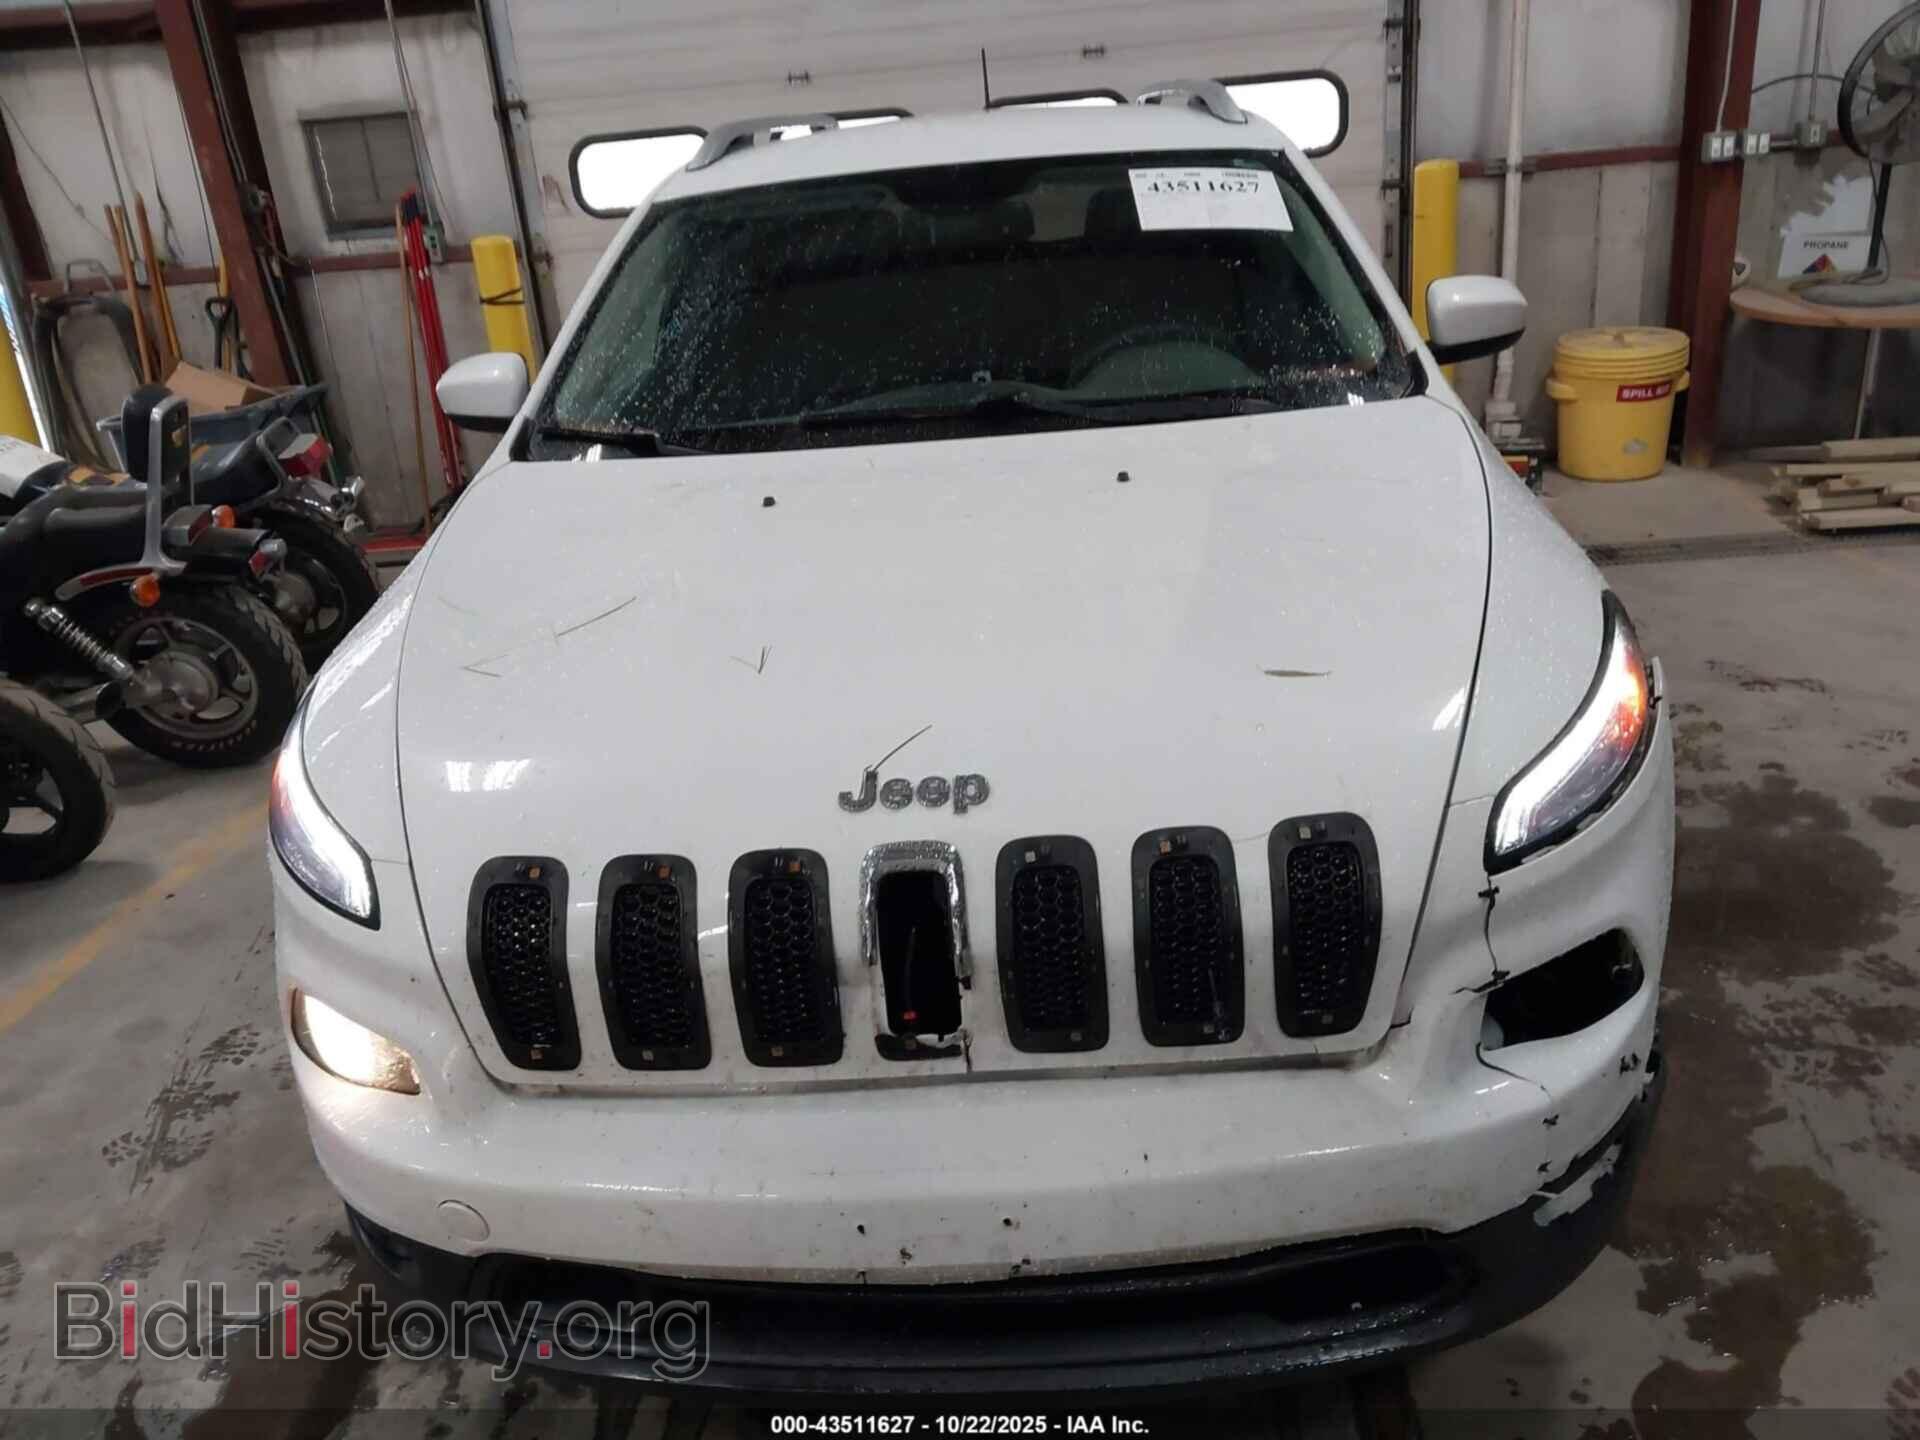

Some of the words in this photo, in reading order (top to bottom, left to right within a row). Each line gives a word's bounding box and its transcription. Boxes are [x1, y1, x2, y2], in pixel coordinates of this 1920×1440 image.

[1147, 181, 1260, 194] 43511627
[1802, 240, 1849, 249] PROPANE
[838, 770, 991, 815] Jeep
